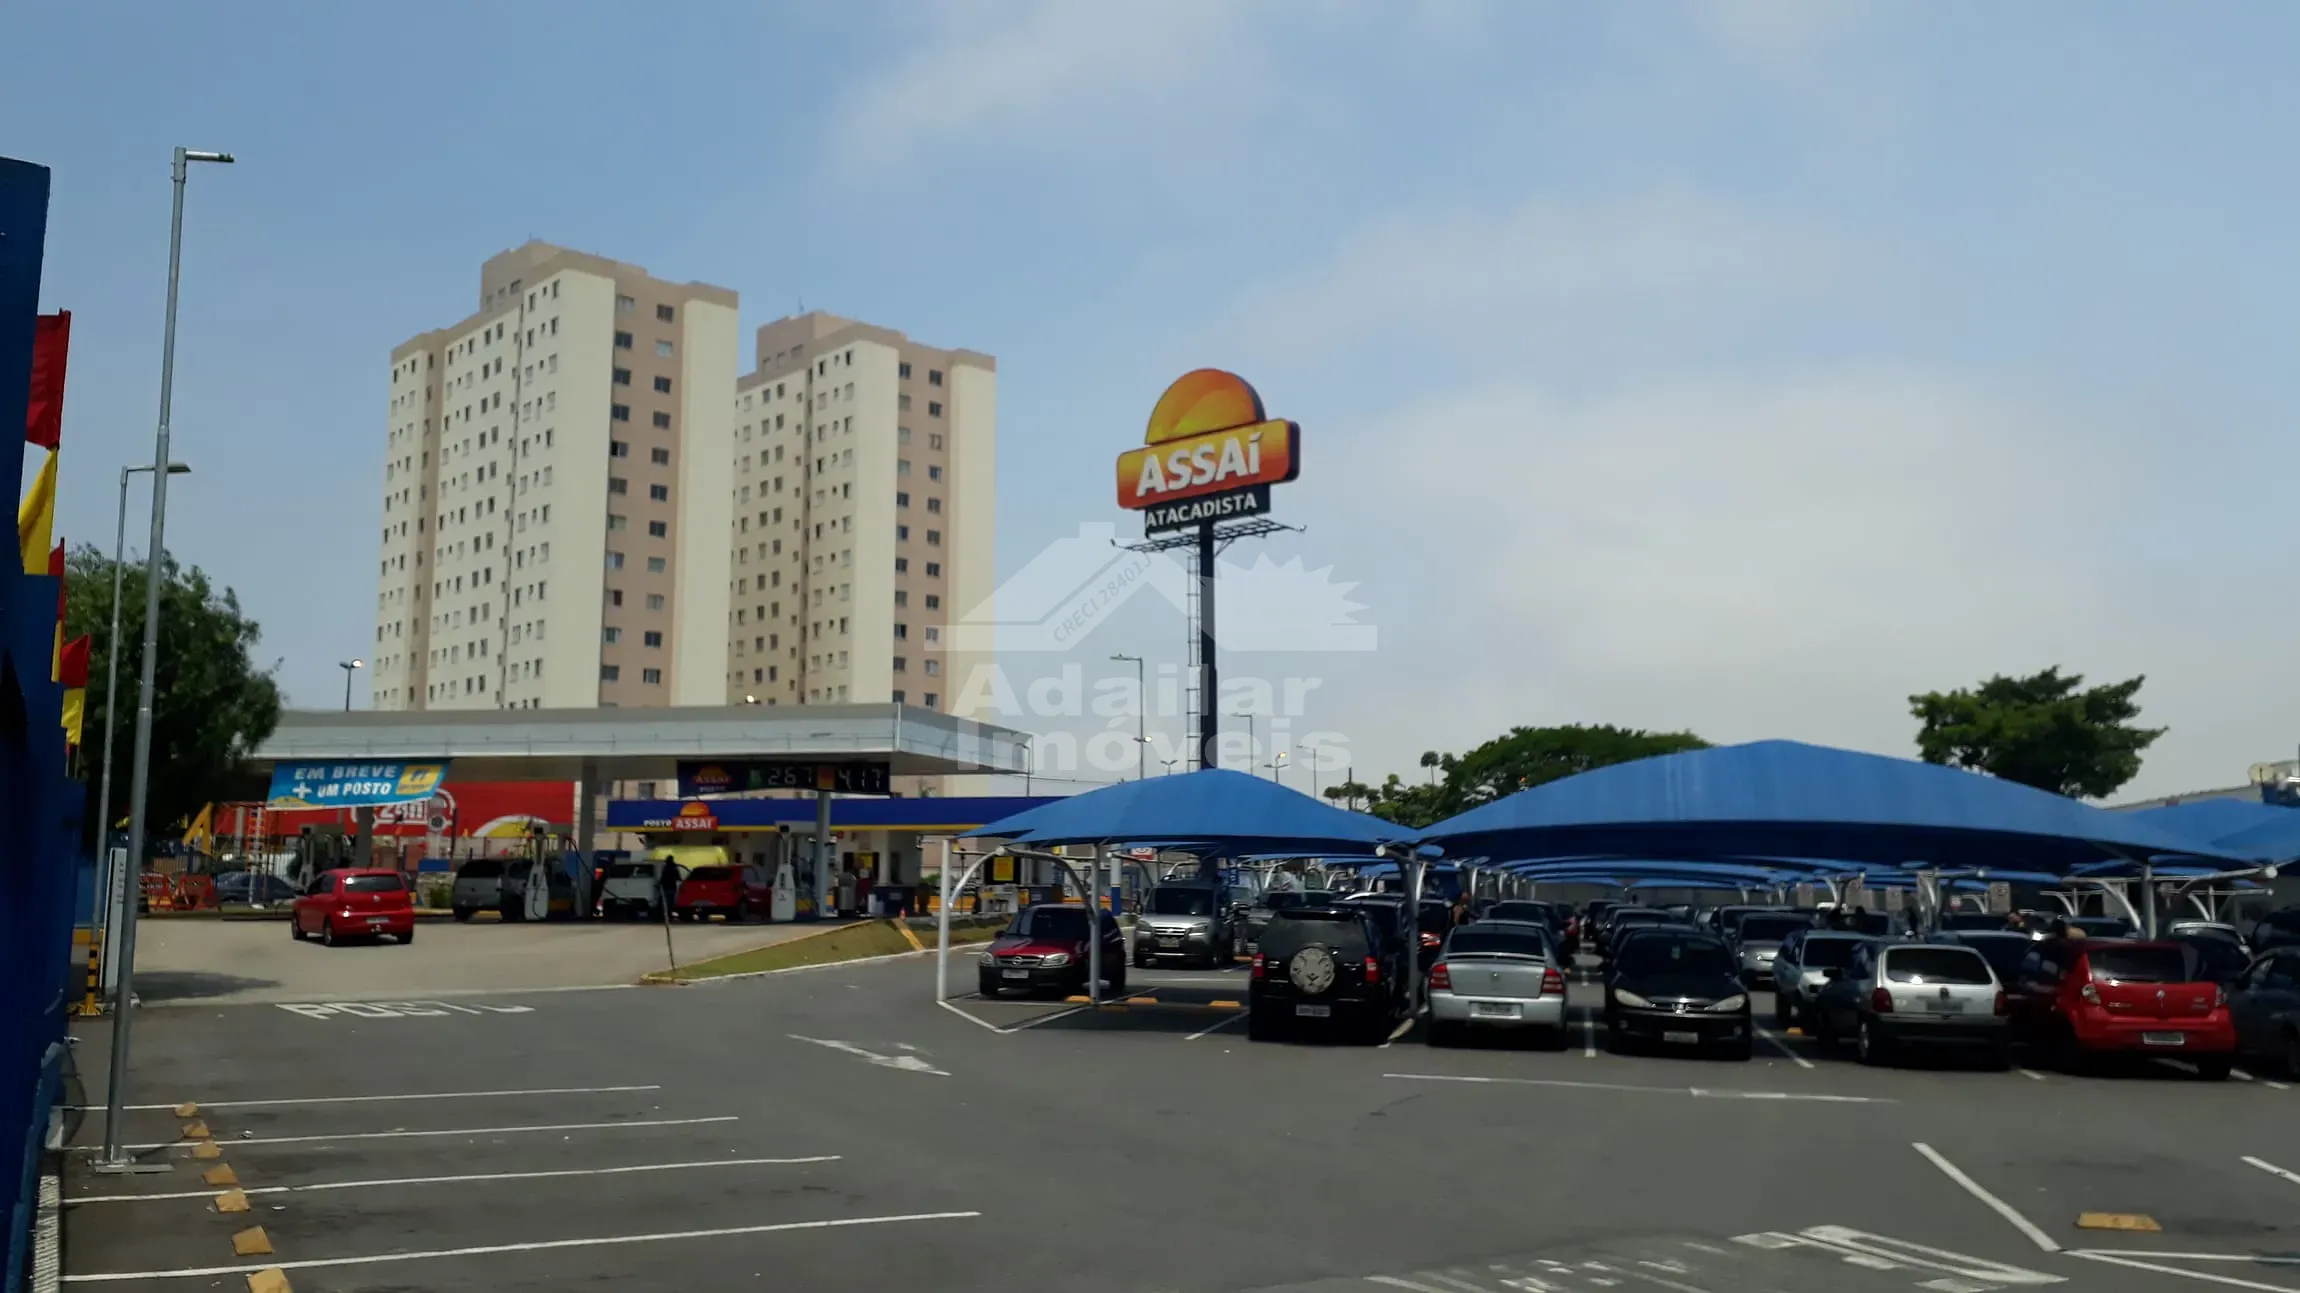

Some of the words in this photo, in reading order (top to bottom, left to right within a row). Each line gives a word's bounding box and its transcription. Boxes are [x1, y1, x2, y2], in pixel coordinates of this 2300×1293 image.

[1146, 492, 1257, 528] ATACADISTA
[294, 767, 325, 780] EM
[332, 765, 398, 779] BREVE
[342, 781, 391, 796] POSTO
